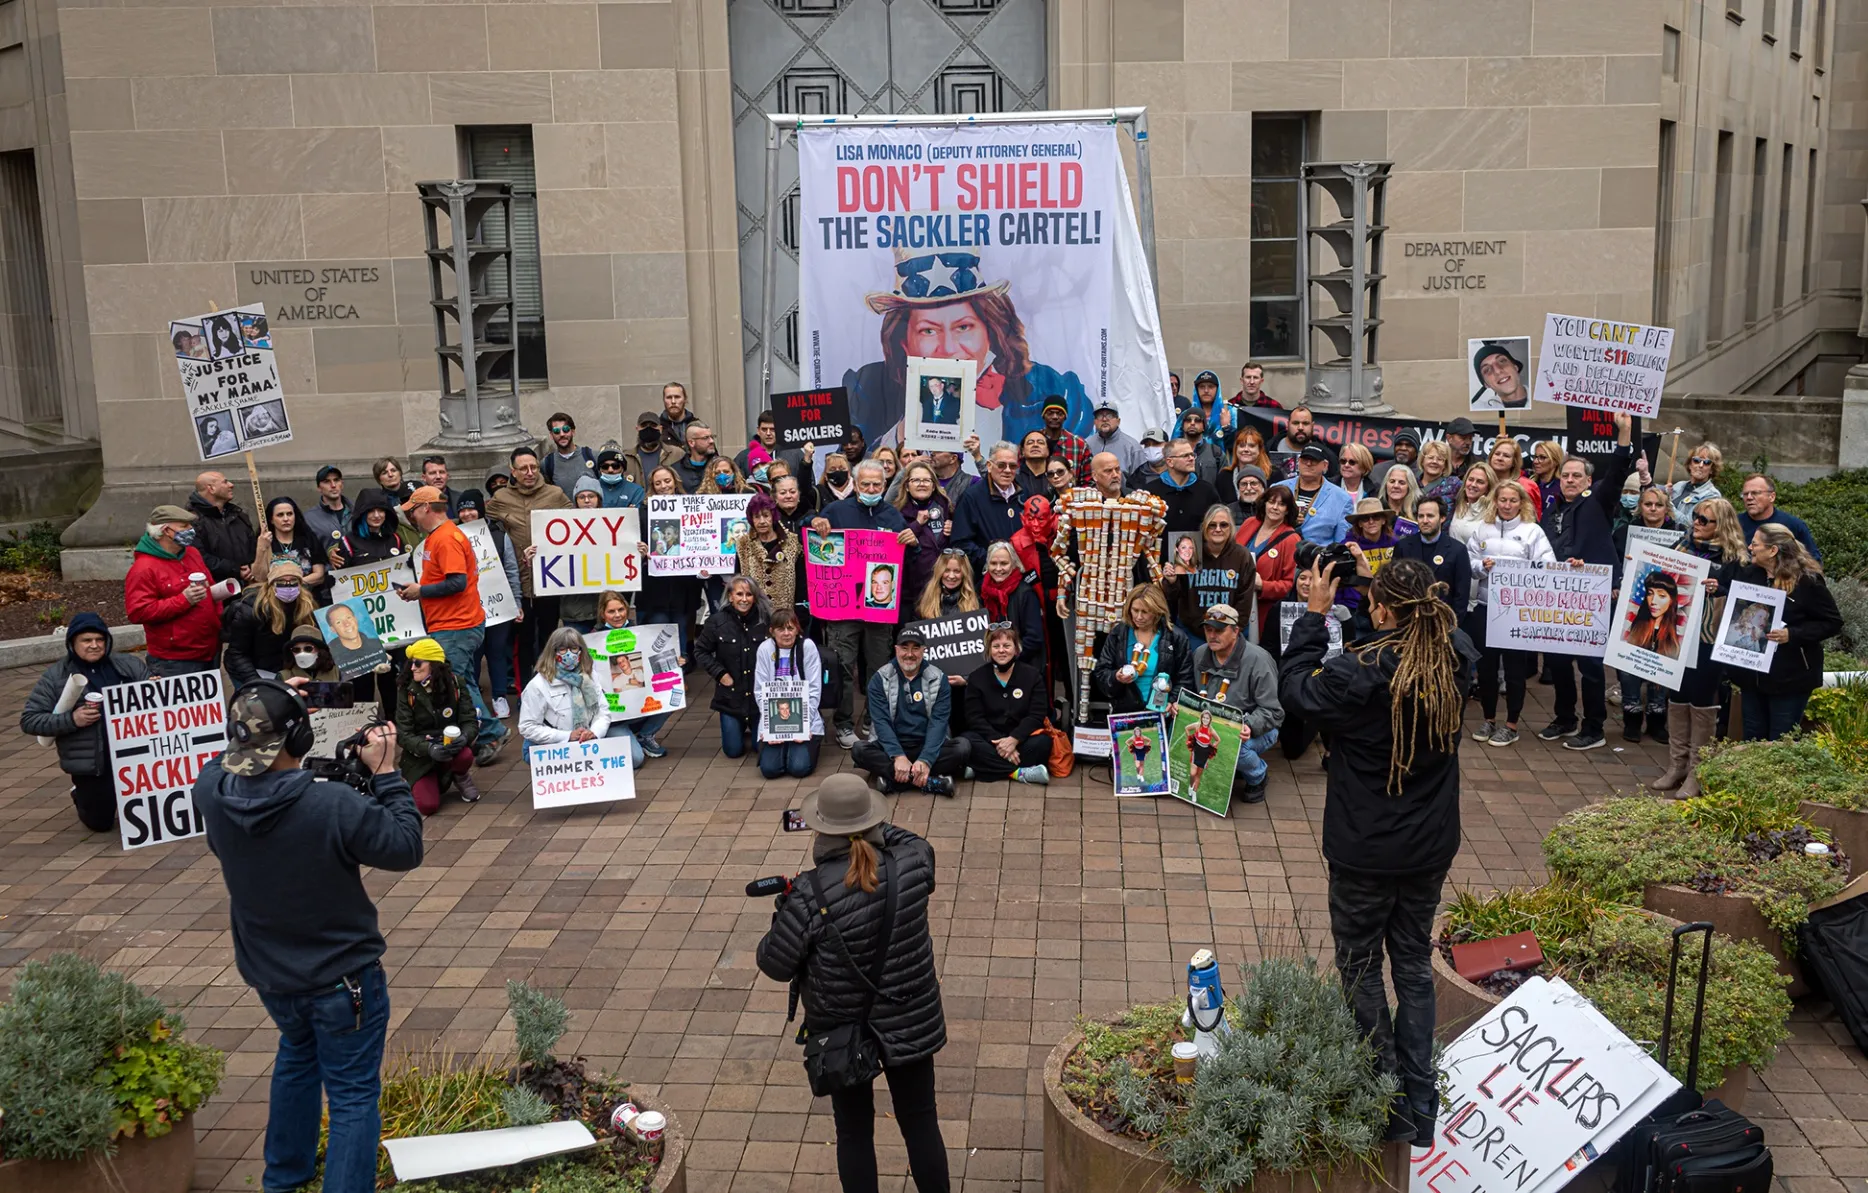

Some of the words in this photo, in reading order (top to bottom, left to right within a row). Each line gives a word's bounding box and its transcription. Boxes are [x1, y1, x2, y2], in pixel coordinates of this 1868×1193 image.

[836, 144, 864, 161] LISA
[867, 144, 922, 160] MONACO
[927, 143, 974, 164] (DEPUTY
[975, 144, 1029, 159] ATTORNEY
[1031, 140, 1083, 158] GENERAL)
[837, 164, 945, 212] DON'T
[956, 162, 1083, 211] SHIELD
[818, 216, 869, 250] THE
[876, 214, 990, 249] SACKLER
[999, 210, 1102, 246] CARTEL!
[1404, 240, 1506, 257] DEPARTMENT
[1444, 259, 1465, 273] OF
[250, 269, 315, 285] UNITED
[321, 267, 379, 284] STATES
[1423, 275, 1486, 290] JUSTICE
[304, 287, 328, 302] OF
[276, 304, 360, 321] AMERICA
[1553, 317, 1586, 338] YOU
[1643, 328, 1669, 349] BE
[195, 353, 261, 377] JUSTICE
[813, 330, 821, 390] WWW.THE-CURTAINS.C
[1553, 343, 1604, 362] WORTH
[1604, 347, 1628, 365] $11
[1627, 352, 1667, 372] BILLION
[217, 372, 249, 388] FOR
[1552, 361, 1579, 376] AND
[1585, 365, 1646, 386] DECLARE
[198, 391, 219, 406] MY
[787, 395, 807, 408] JAIL
[808, 392, 832, 406] TIME
[800, 408, 822, 422] FOR
[1582, 409, 1601, 421] JAIL
[784, 424, 843, 443] SACKLERS
[1593, 423, 1613, 436] FOR
[1576, 440, 1634, 453] SACKLES
[651, 499, 677, 512] DOJ
[682, 496, 706, 505] MAKE
[706, 498, 746, 511] SACKLERS
[681, 512, 713, 526] PAY!!!
[545, 516, 625, 546] OXY
[848, 531, 885, 547] Purdue
[653, 558, 667, 568] WE
[673, 557, 696, 569] MISS
[699, 556, 715, 567] YOU
[848, 547, 887, 560] Pharma
[541, 553, 638, 588] KILL$
[1491, 572, 1548, 589] FOLLOW
[1553, 576, 1591, 593] THE
[363, 595, 386, 614] DO
[487, 592, 504, 606] AND
[1198, 590, 1230, 607] TECH
[1500, 588, 1557, 607] BLOOD
[1557, 592, 1609, 612] MONEY
[917, 618, 964, 639] HAME
[966, 614, 989, 631] ON
[1519, 608, 1594, 627] EVIDENCE
[106, 673, 218, 715] HARVARD
[111, 712, 159, 740] TAKE
[163, 702, 223, 732] DOWN
[150, 732, 190, 758] THAT
[534, 747, 570, 761] TIME
[580, 743, 600, 756] TO
[535, 760, 594, 777] HAMMER
[600, 755, 626, 770] THE
[1482, 1005, 1620, 1129] SACKLERS
[1477, 1063, 1540, 1126] LIE
[1436, 1080, 1539, 1191] HILDREN
